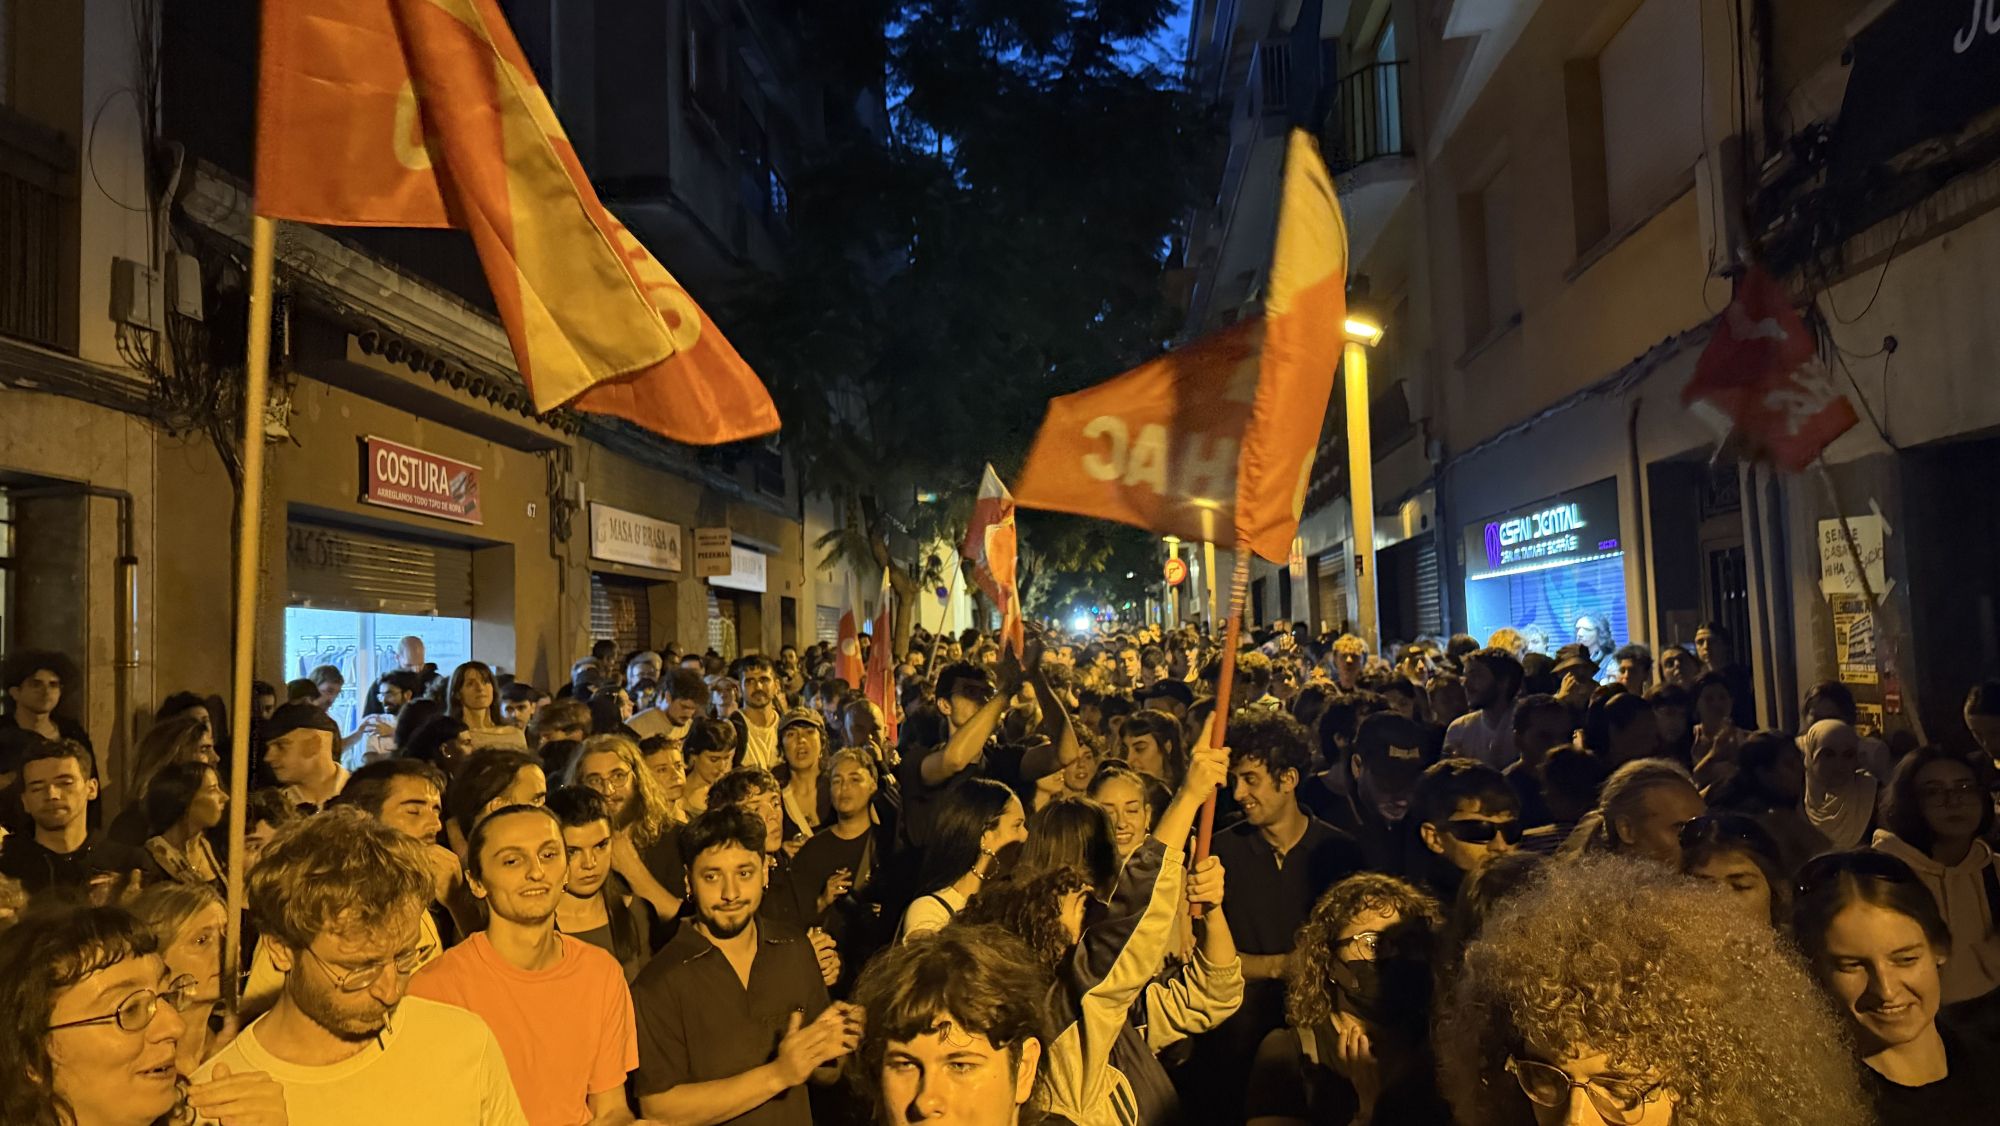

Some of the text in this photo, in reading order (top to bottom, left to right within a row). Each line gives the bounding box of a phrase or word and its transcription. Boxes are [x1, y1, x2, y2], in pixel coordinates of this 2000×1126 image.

[376, 448, 450, 497] COSTURA
[414, 495, 428, 507] TODO
[527, 502, 537, 518] 67
[609, 517, 633, 543] MASA
[642, 525, 667, 550] BRASA
[1532, 503, 1587, 539] DENTAL
[1825, 527, 1859, 544] SENE
